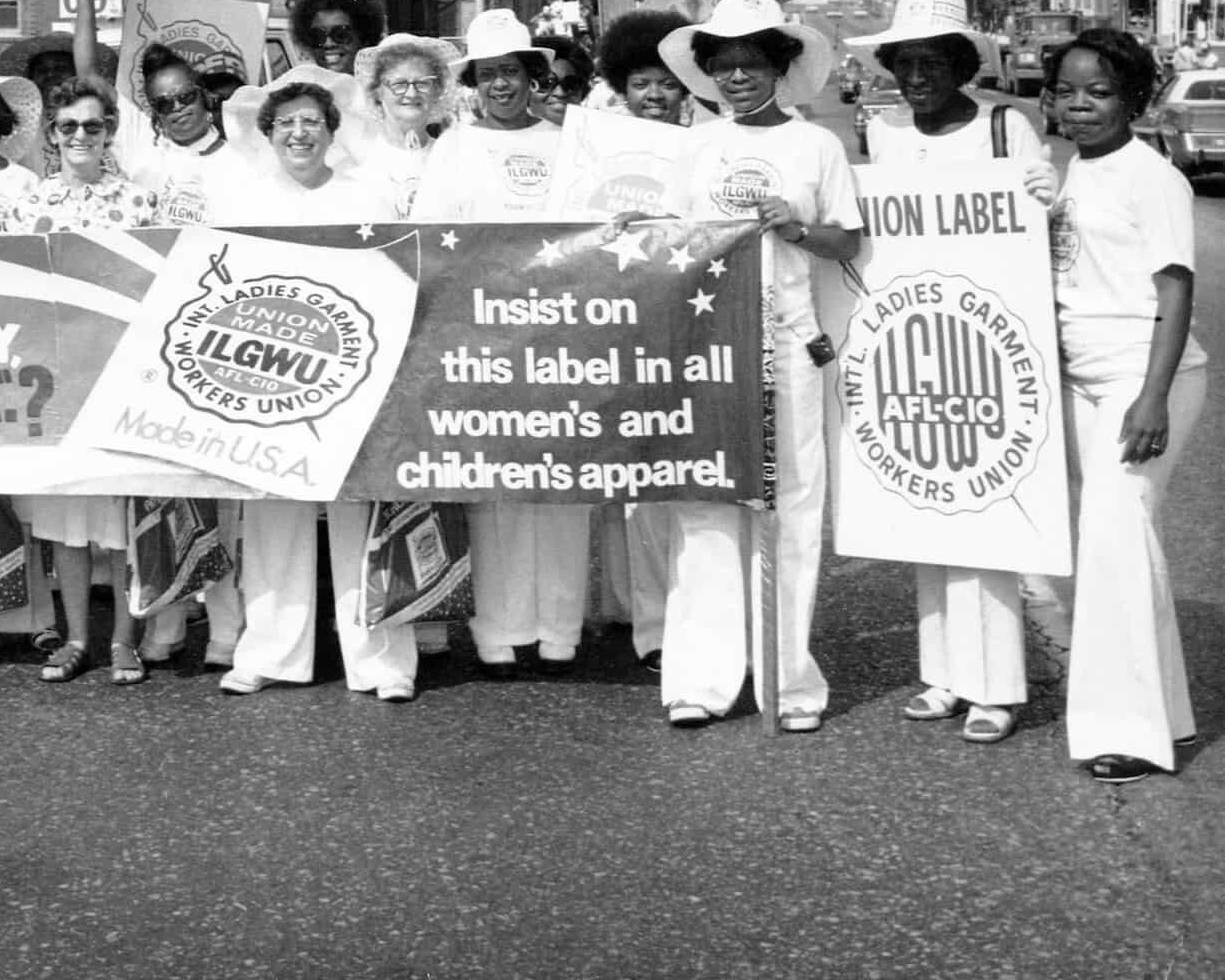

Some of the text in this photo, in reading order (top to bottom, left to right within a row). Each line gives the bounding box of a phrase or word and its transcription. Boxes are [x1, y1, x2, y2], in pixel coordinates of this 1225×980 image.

[935, 190, 1026, 236] LABEL
[220, 285, 301, 305] LADIES
[306, 293, 361, 369] GARMENT
[236, 302, 330, 333] UNION
[473, 288, 637, 325] Insist on
[231, 315, 318, 346] MADE
[862, 282, 943, 335] LADIES
[959, 290, 1039, 415] GARMENT
[174, 340, 342, 414] WORKERS UNION
[196, 330, 328, 385] ILGWU
[440, 344, 734, 385] this label in all
[114, 406, 195, 449] Made
[196, 427, 227, 458] in
[427, 397, 694, 438] women's and
[882, 394, 1000, 425] AFL-CIO
[396, 450, 735, 498] children's apparel.
[855, 421, 1033, 503] WORKERS UNION
